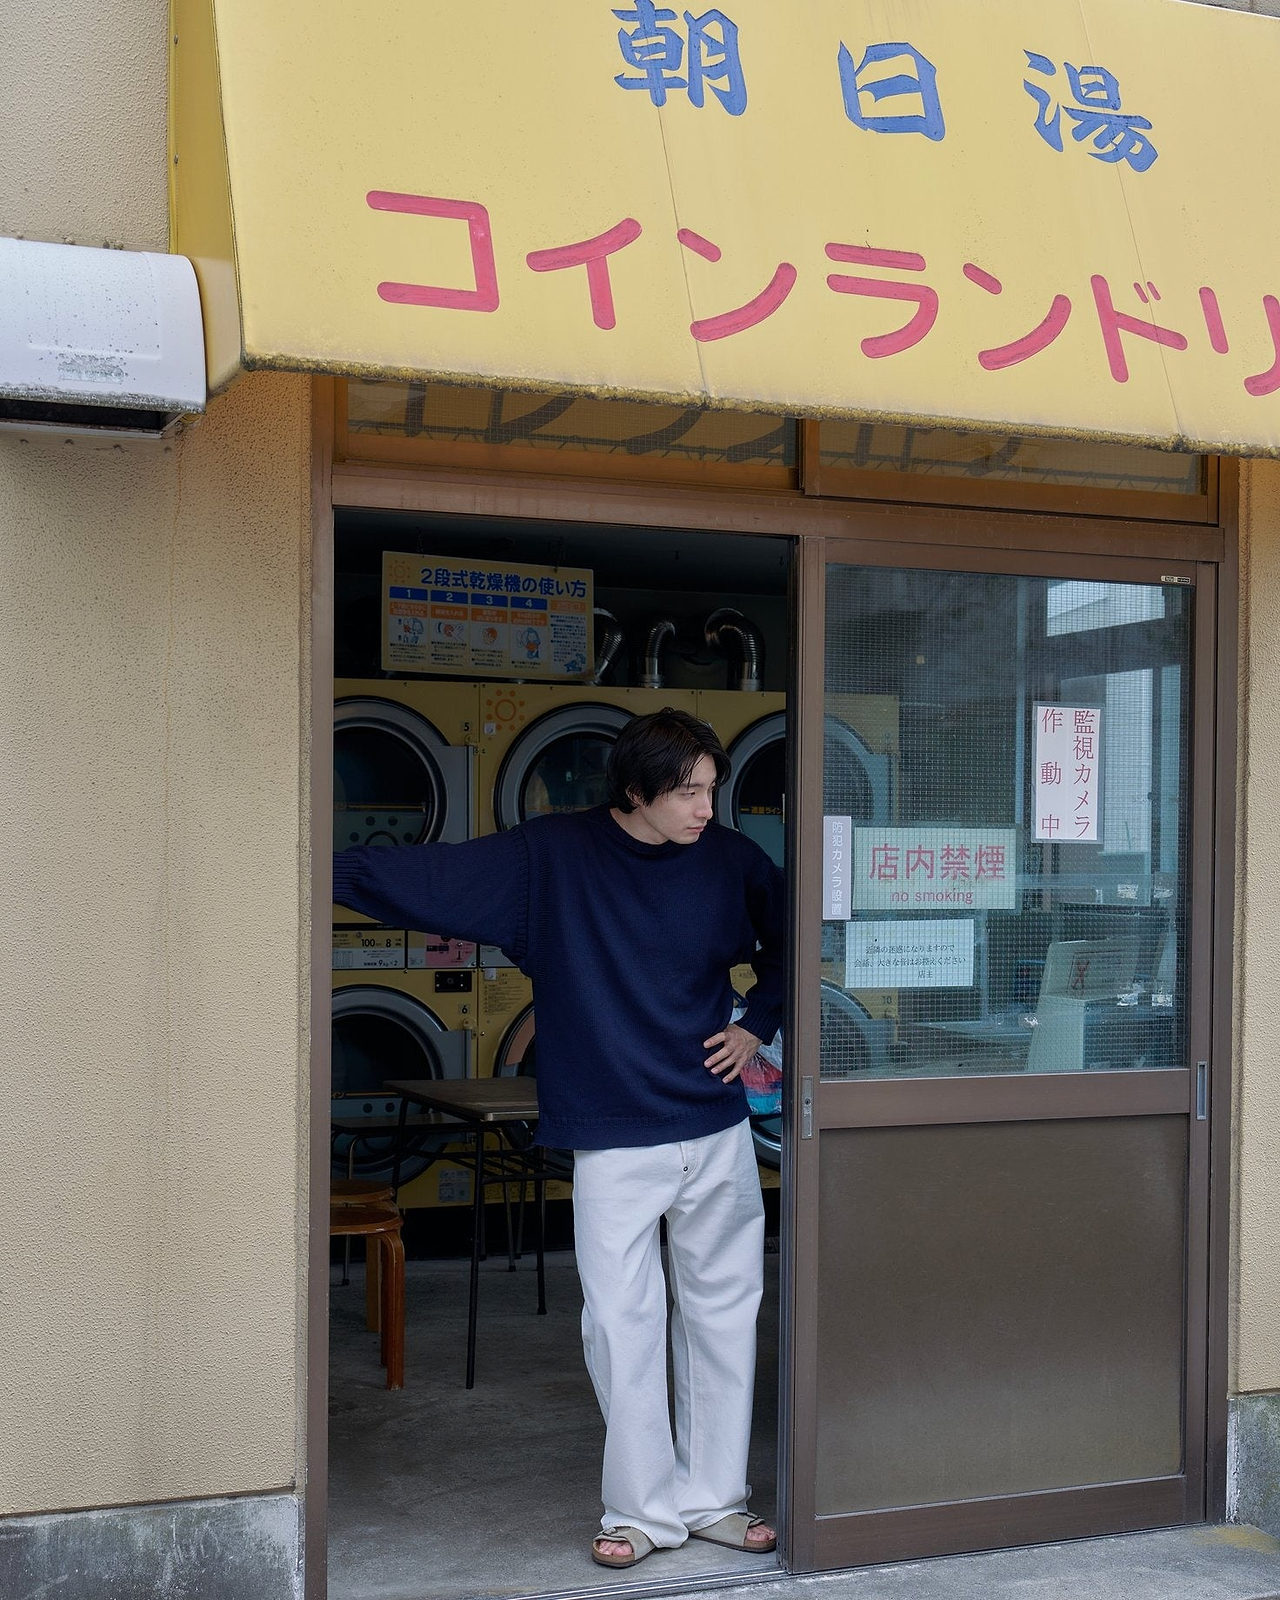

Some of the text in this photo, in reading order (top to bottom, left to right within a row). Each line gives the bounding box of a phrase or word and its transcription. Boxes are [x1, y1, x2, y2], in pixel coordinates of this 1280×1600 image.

[614, 0, 1159, 173] 朝日湯
[420, 568, 587, 598] 2段式乾燥機の使い方
[446, 593, 453, 601] 2
[486, 596, 493, 605] 3
[525, 599, 532, 608] 4
[1040, 708, 1064, 838] 作動中
[1073, 710, 1095, 838] 監視カメラ
[831, 821, 844, 916] 防犯カメラ設置
[869, 843, 1005, 880] 店内禁煙
[891, 891, 974, 905] no smoking
[361, 938, 376, 947] 100
[917, 970, 934, 979] 店主
[461, 1005, 468, 1014] 6
